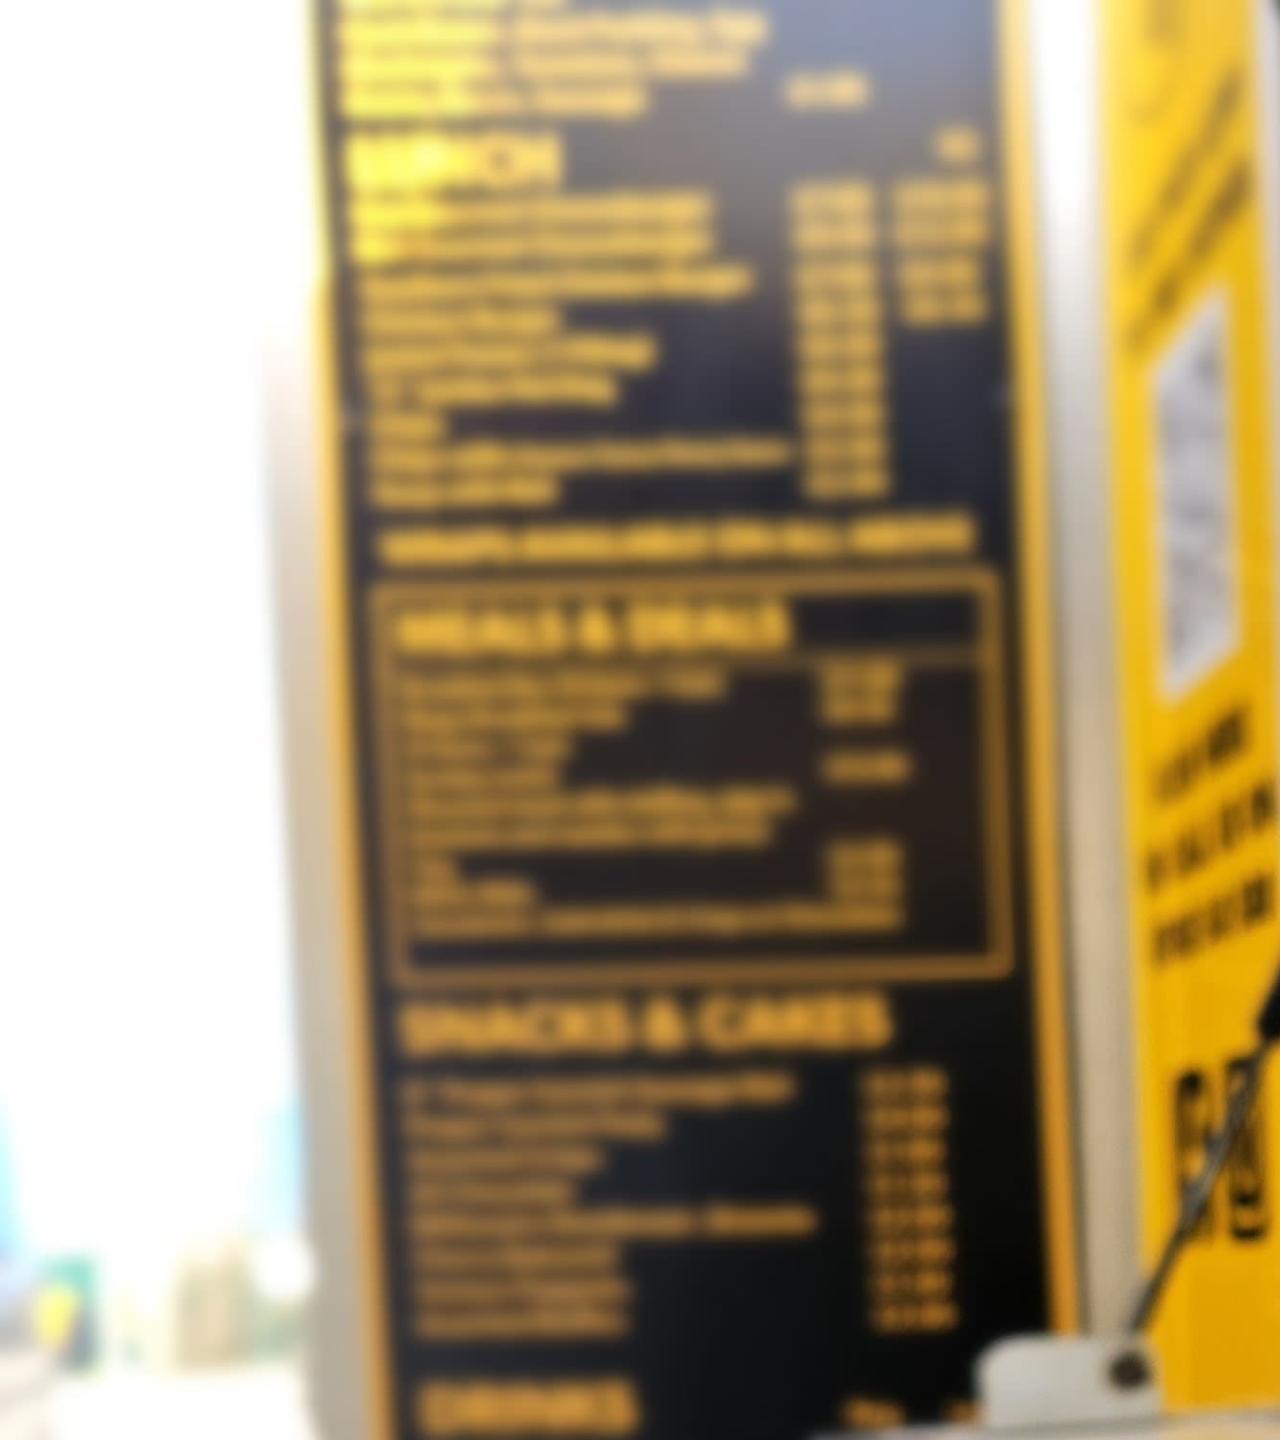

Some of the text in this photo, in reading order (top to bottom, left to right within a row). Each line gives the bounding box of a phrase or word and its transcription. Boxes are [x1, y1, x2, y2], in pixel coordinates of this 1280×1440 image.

[401, 598, 792, 655] MEALS & DEALS
[400, 991, 894, 1055] SNACKS & CAKES
